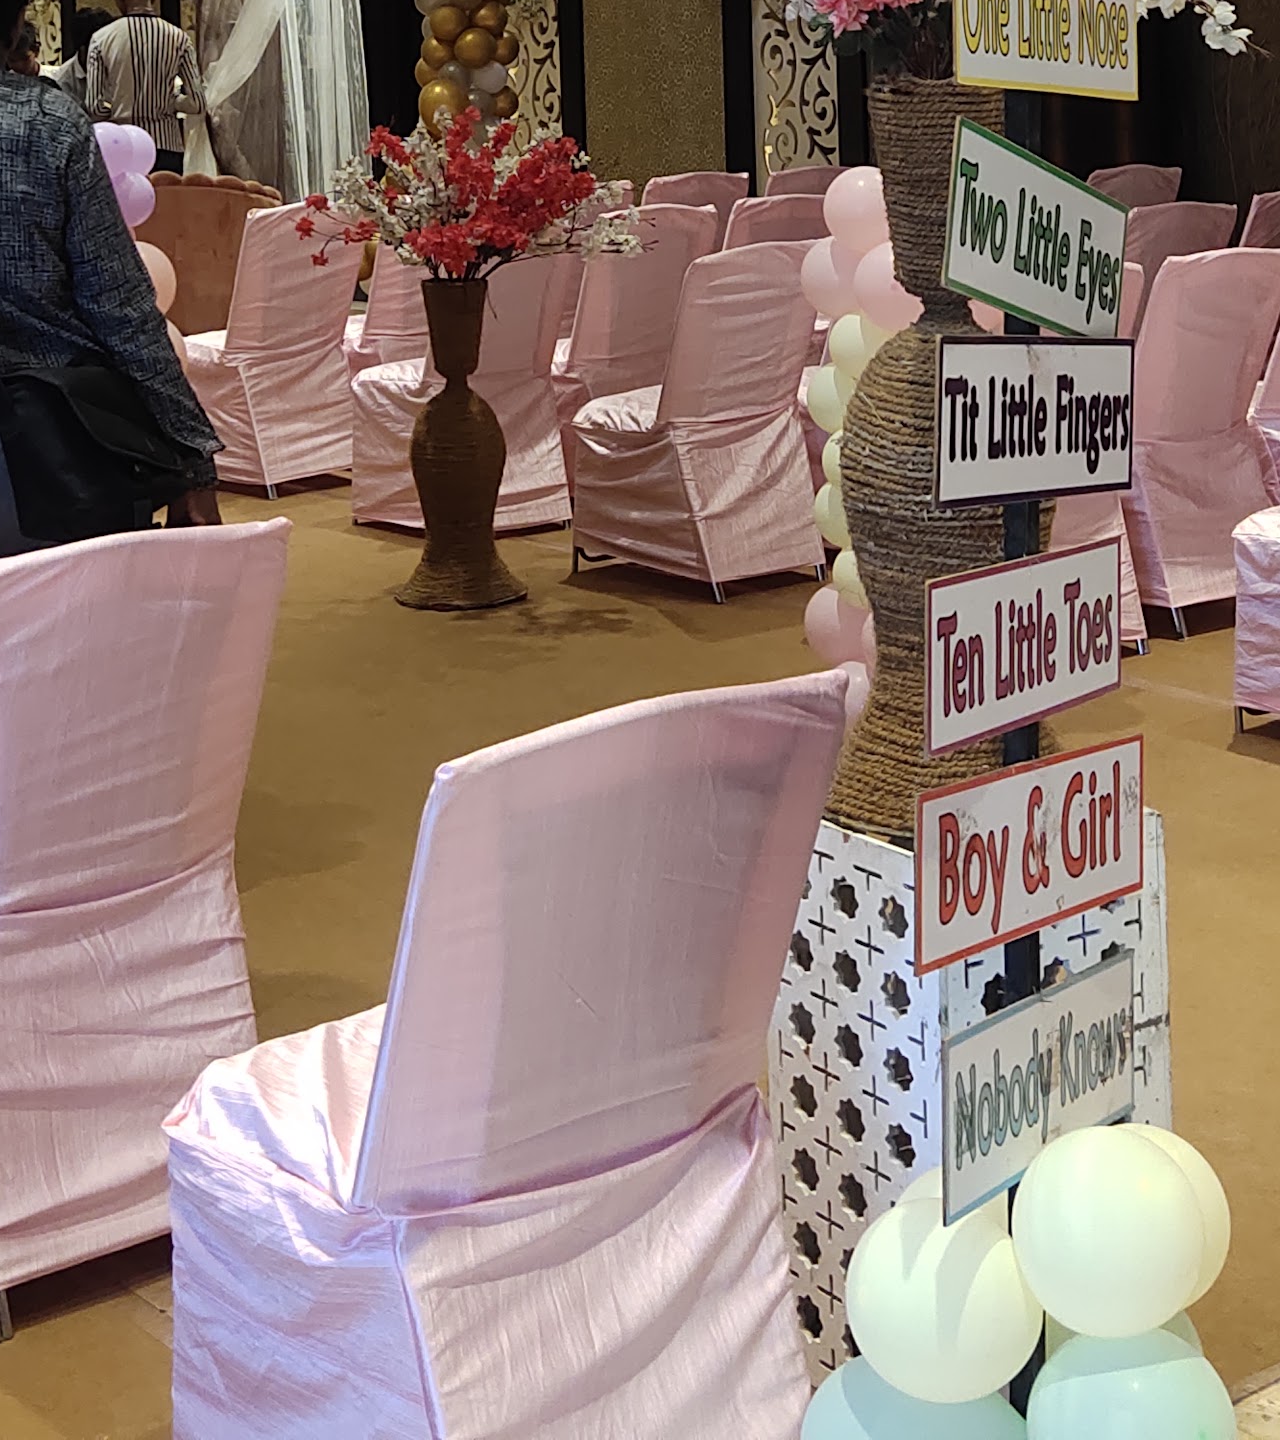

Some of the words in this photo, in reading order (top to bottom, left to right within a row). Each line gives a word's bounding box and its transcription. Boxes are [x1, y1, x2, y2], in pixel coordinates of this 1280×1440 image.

[960, 158, 1008, 263] Two
[1014, 188, 1070, 292] Little
[1075, 219, 1119, 324] Eyes
[945, 375, 979, 462] Tit
[988, 374, 1047, 459] Little
[1056, 374, 1129, 474] Fingers
[937, 611, 984, 718] Ten
[995, 588, 1057, 700] Little
[1064, 578, 1112, 674] Toes
[939, 812, 1009, 934] Boy
[1023, 785, 1049, 894] &
[1061, 760, 1120, 878] Girl
[955, 1028, 1052, 1171] Nobody
